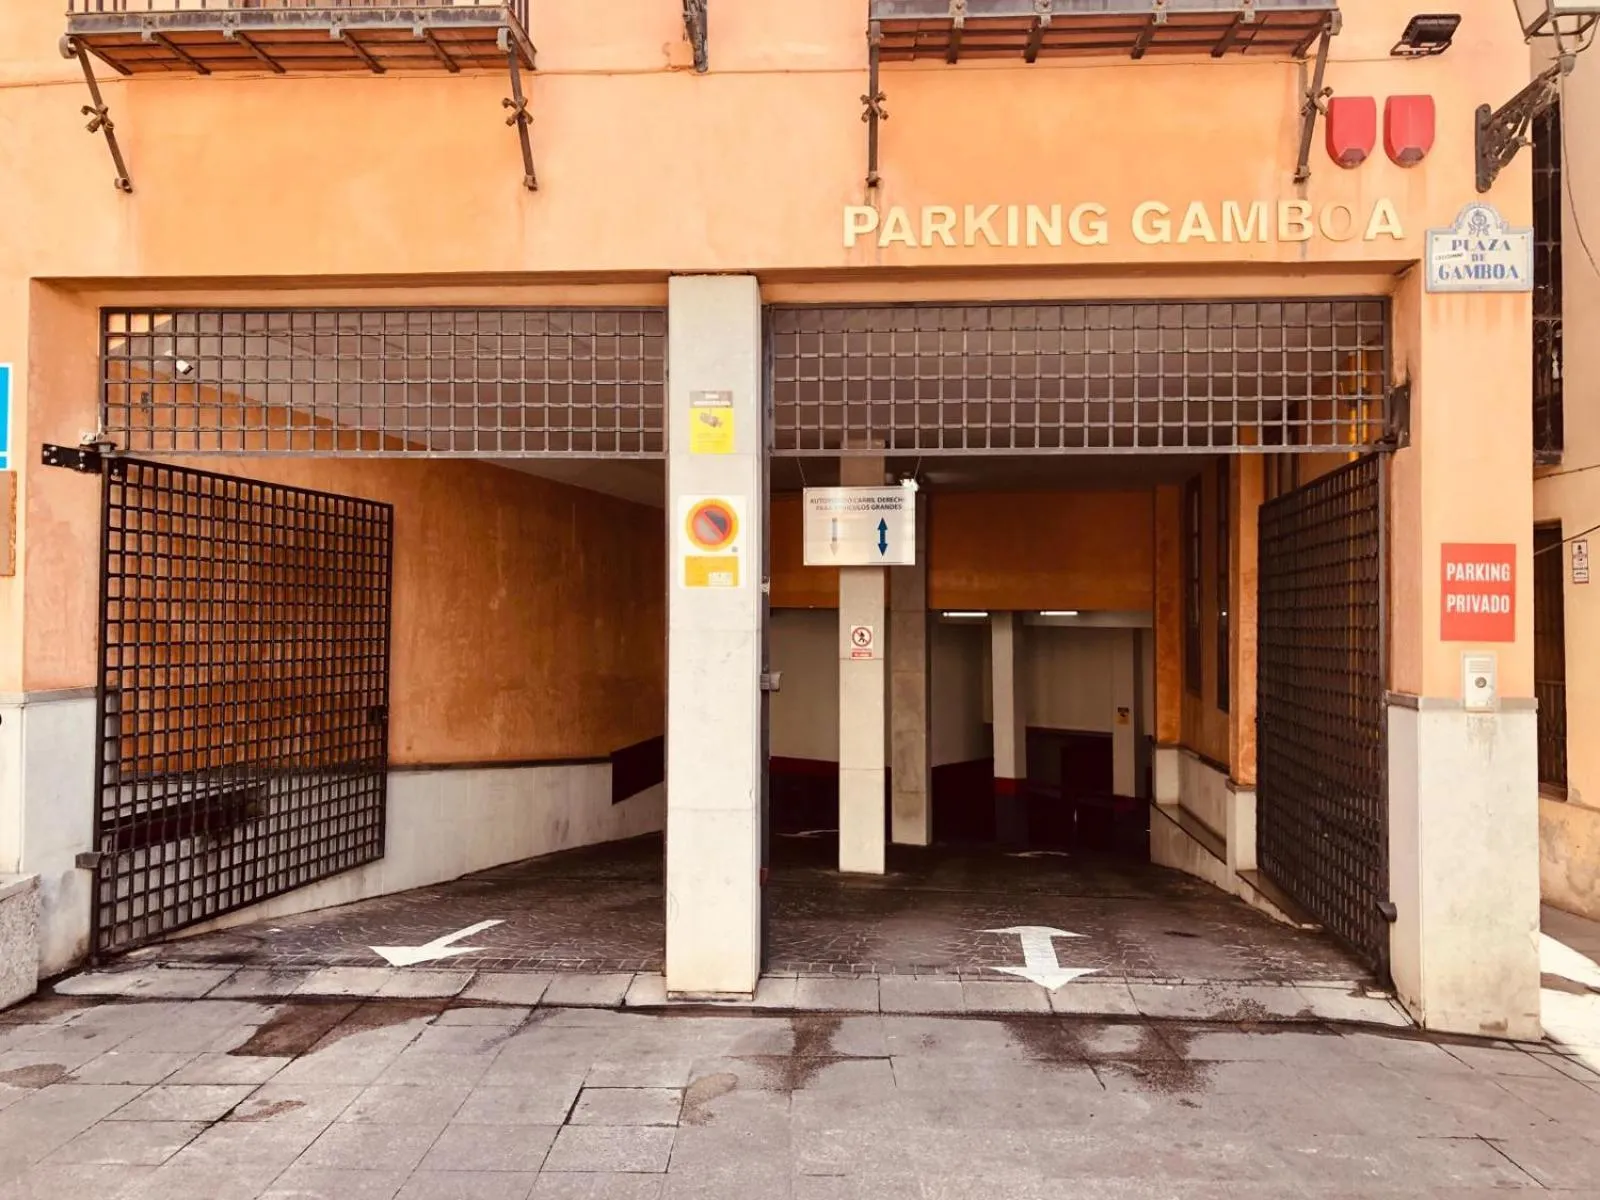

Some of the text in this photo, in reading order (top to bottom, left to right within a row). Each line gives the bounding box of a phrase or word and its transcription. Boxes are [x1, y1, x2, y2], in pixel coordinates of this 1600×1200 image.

[842, 198, 1405, 248] PARKING GAMBOA
[1452, 239, 1511, 250] PLAZA
[1471, 253, 1485, 261] DE
[1438, 263, 1519, 281] GAMBOA
[870, 503, 903, 511] GRANDES
[1446, 562, 1511, 582] PARKING
[1446, 594, 1510, 613] PRIVADO
